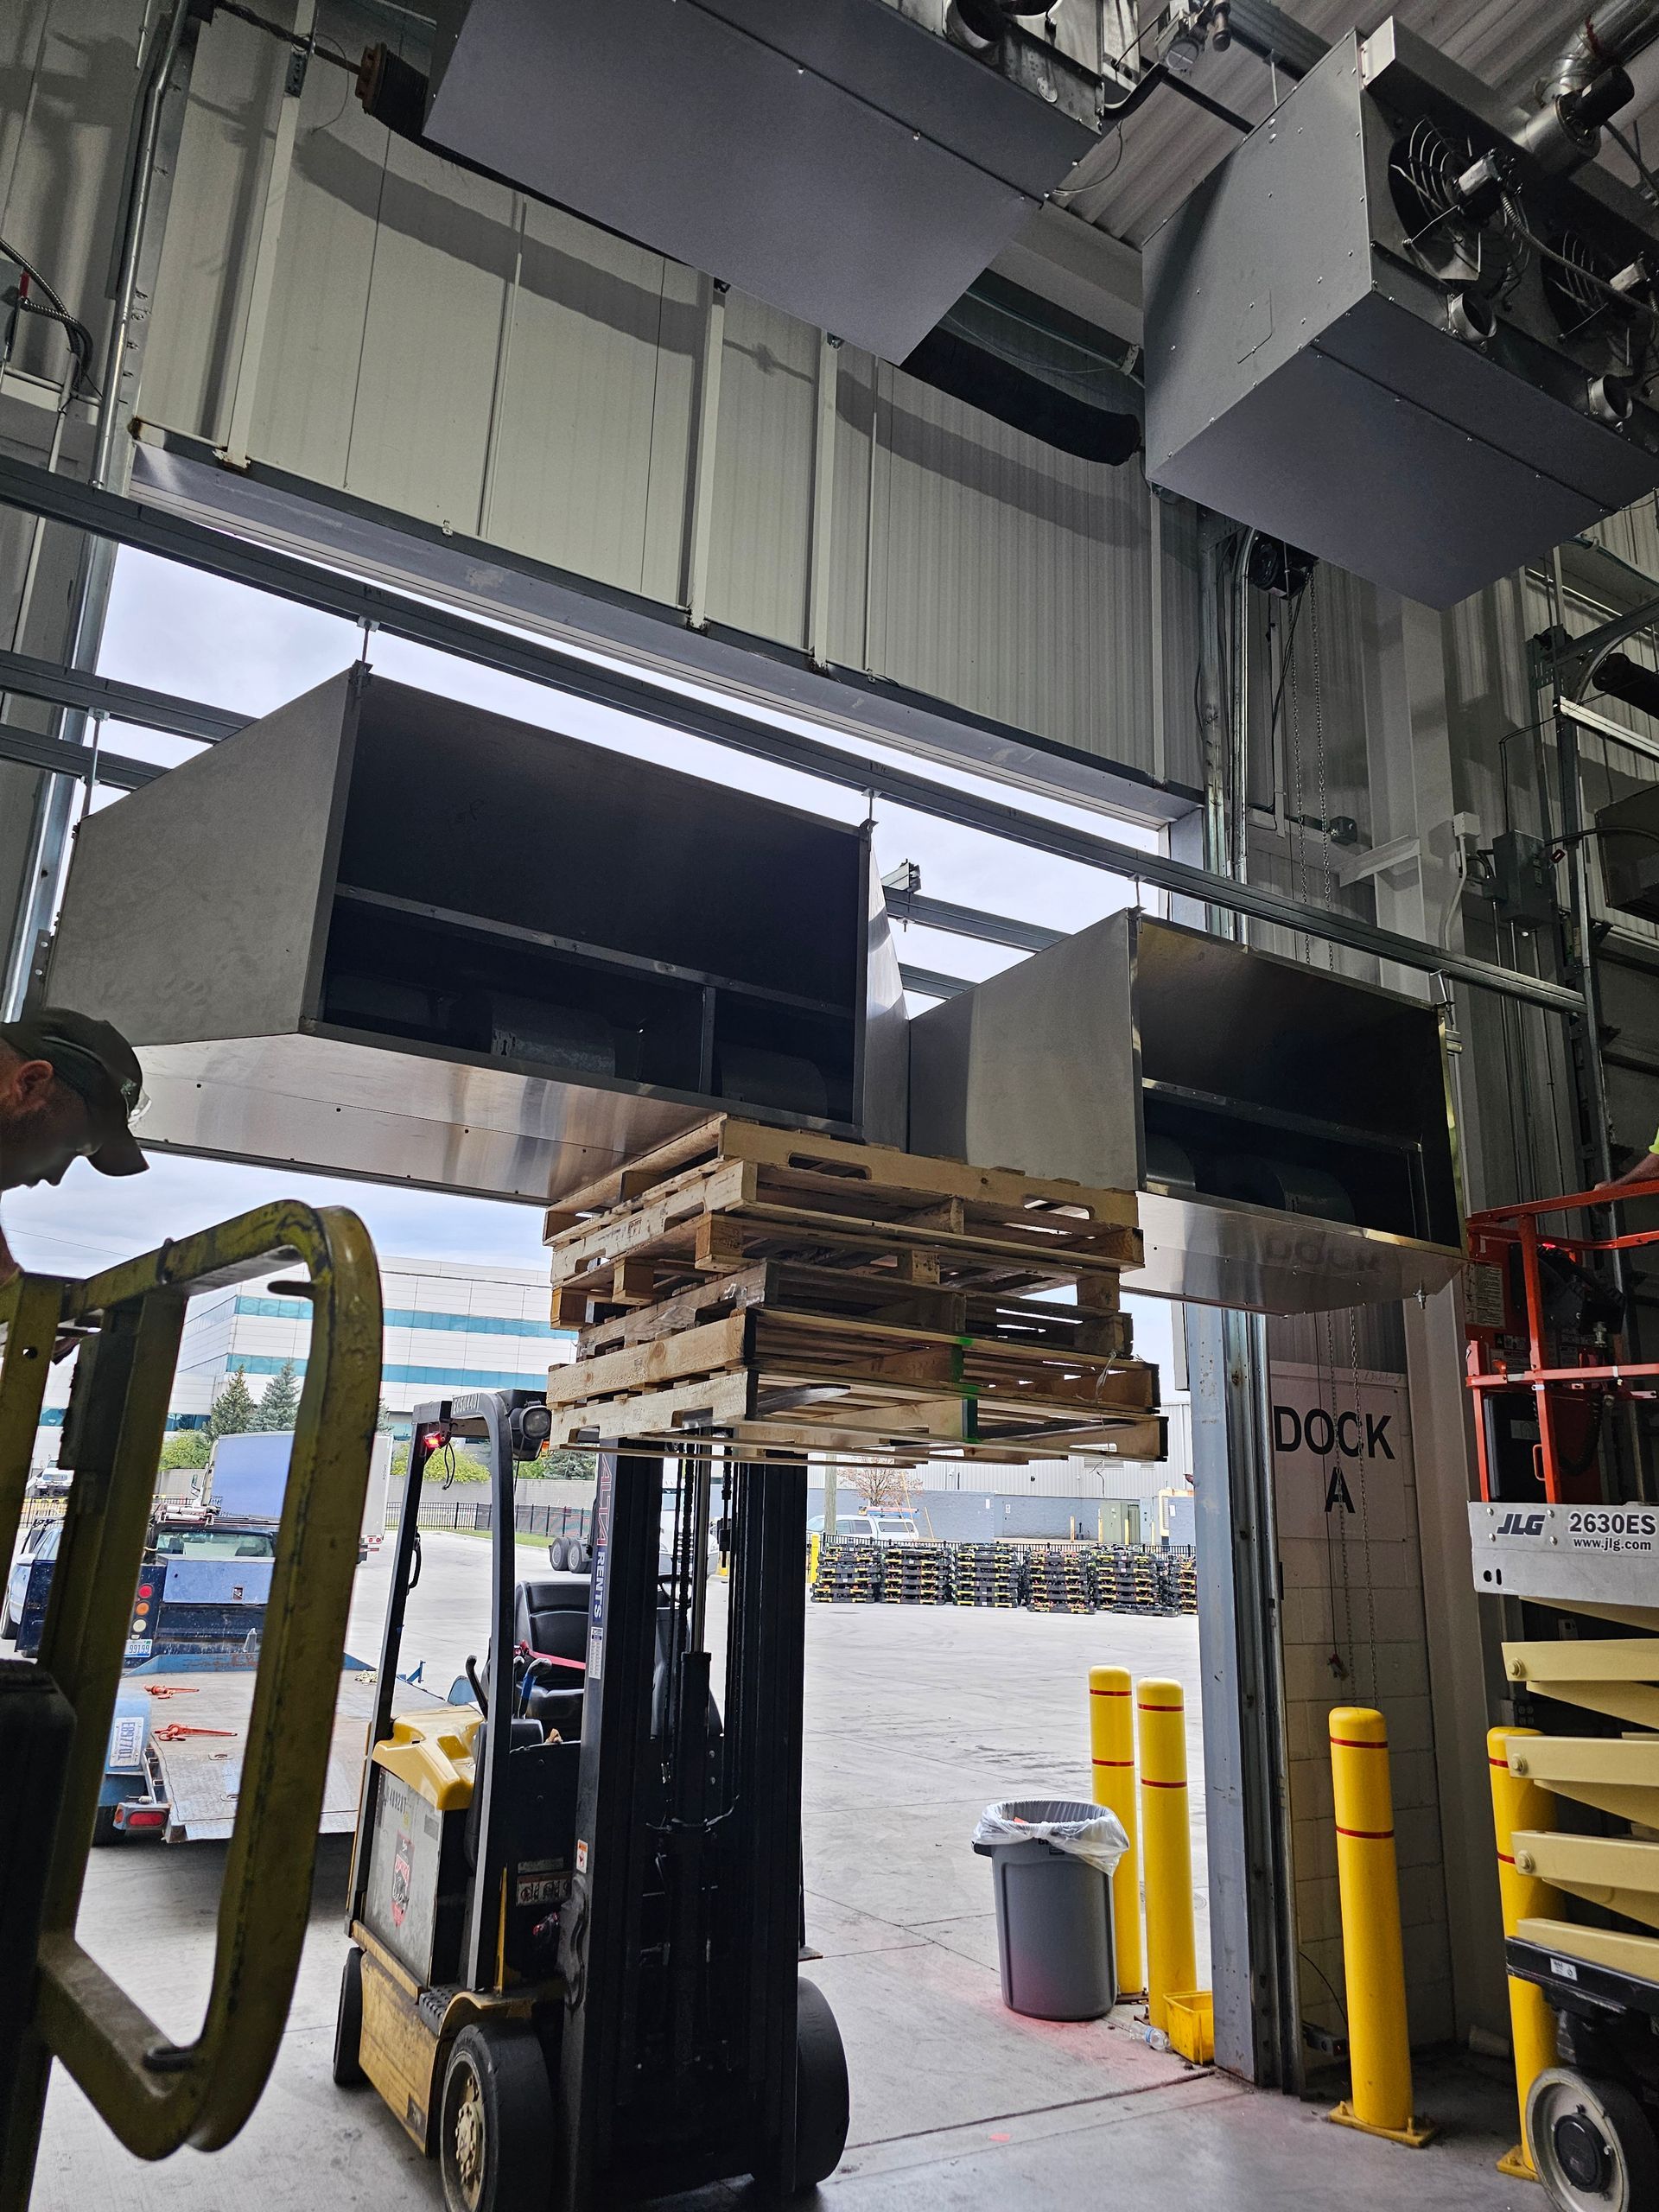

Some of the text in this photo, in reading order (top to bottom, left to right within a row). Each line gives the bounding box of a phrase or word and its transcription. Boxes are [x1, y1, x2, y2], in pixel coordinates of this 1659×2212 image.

[1274, 1405, 1395, 1459] DOCK
[1324, 1466, 1356, 1514] A
[1497, 1513, 1546, 1536] JLG
[1569, 1512, 1656, 1535] 2630ES
[1573, 1537, 1651, 1552] www.jlg.com
[594, 1551, 606, 1618] RENTS
